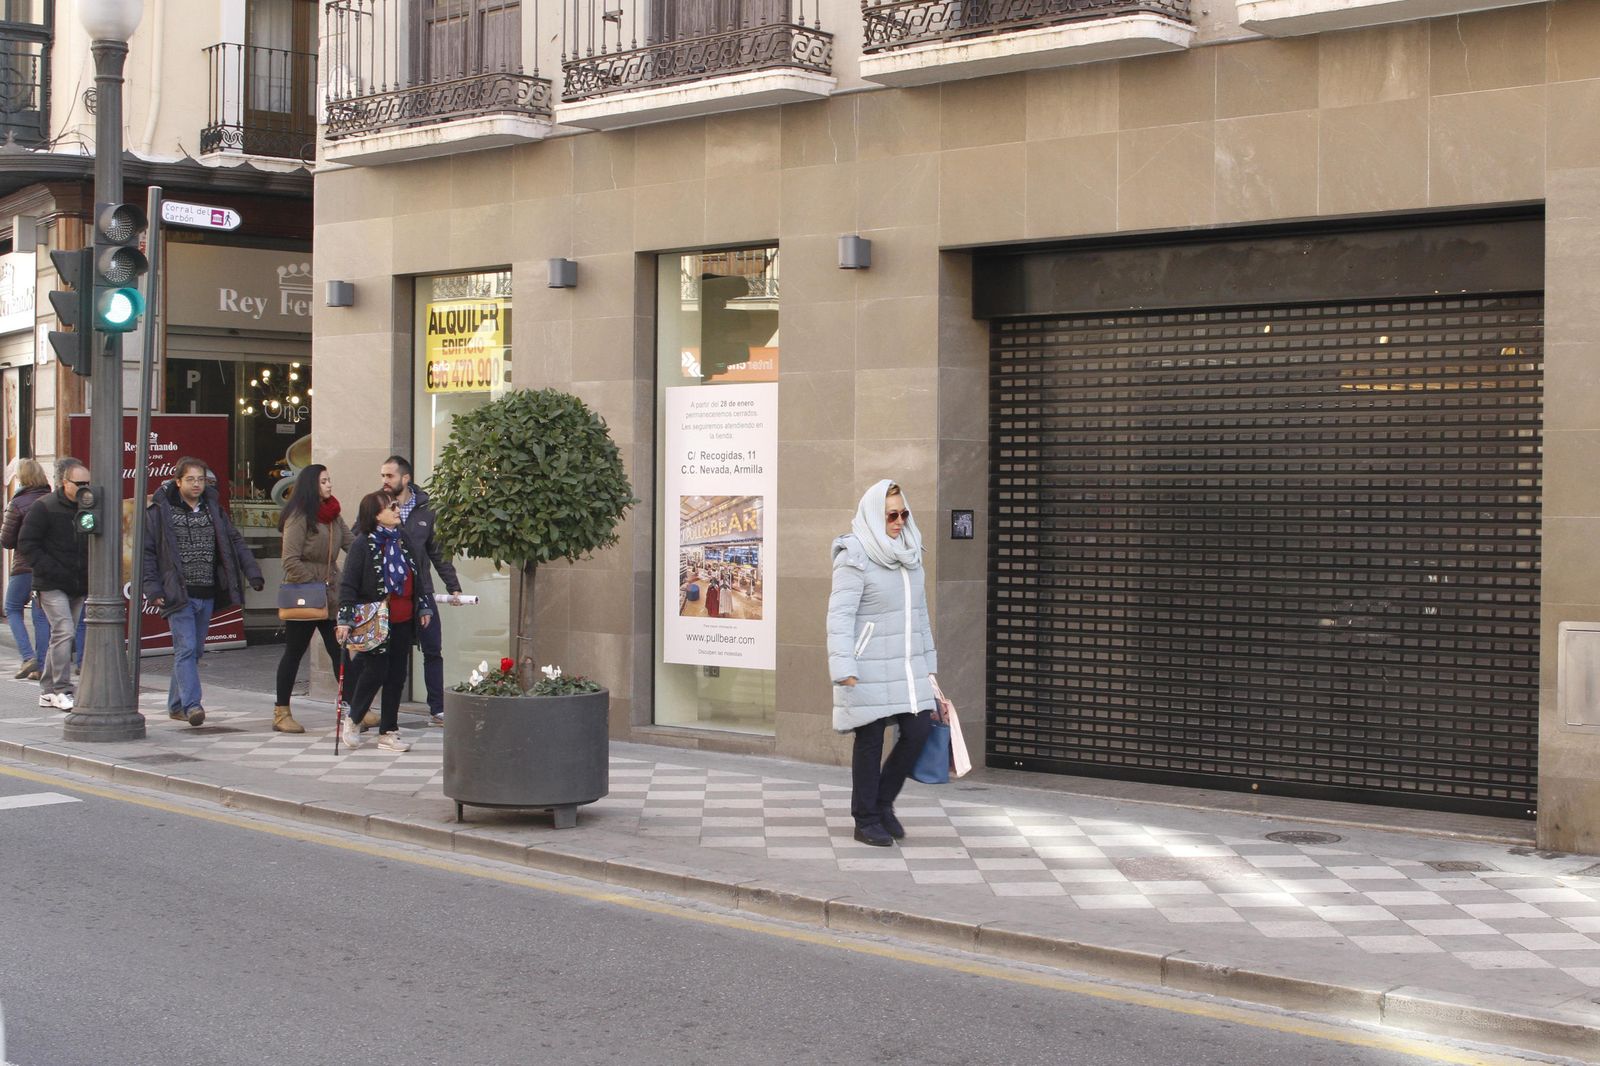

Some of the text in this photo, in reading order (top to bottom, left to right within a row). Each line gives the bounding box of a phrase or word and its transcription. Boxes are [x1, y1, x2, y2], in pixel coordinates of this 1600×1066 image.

[165, 203, 210, 216] Corral del
[165, 212, 194, 222] Carbón
[218, 287, 267, 319] Rey
[428, 303, 499, 335] ALQUILER
[442, 338, 484, 355] EDIFICIO
[452, 358, 474, 387] 470
[478, 357, 499, 386] 900
[264, 402, 309, 421] One
[695, 401, 709, 409] partir
[150, 441, 178, 452] rnando
[687, 450, 756, 462] C/ Recogidas, 11
[123, 462, 177, 479] utntic
[681, 464, 763, 475] C.C. Nevada, Armilla
[685, 633, 755, 645] www.pullbear.com
